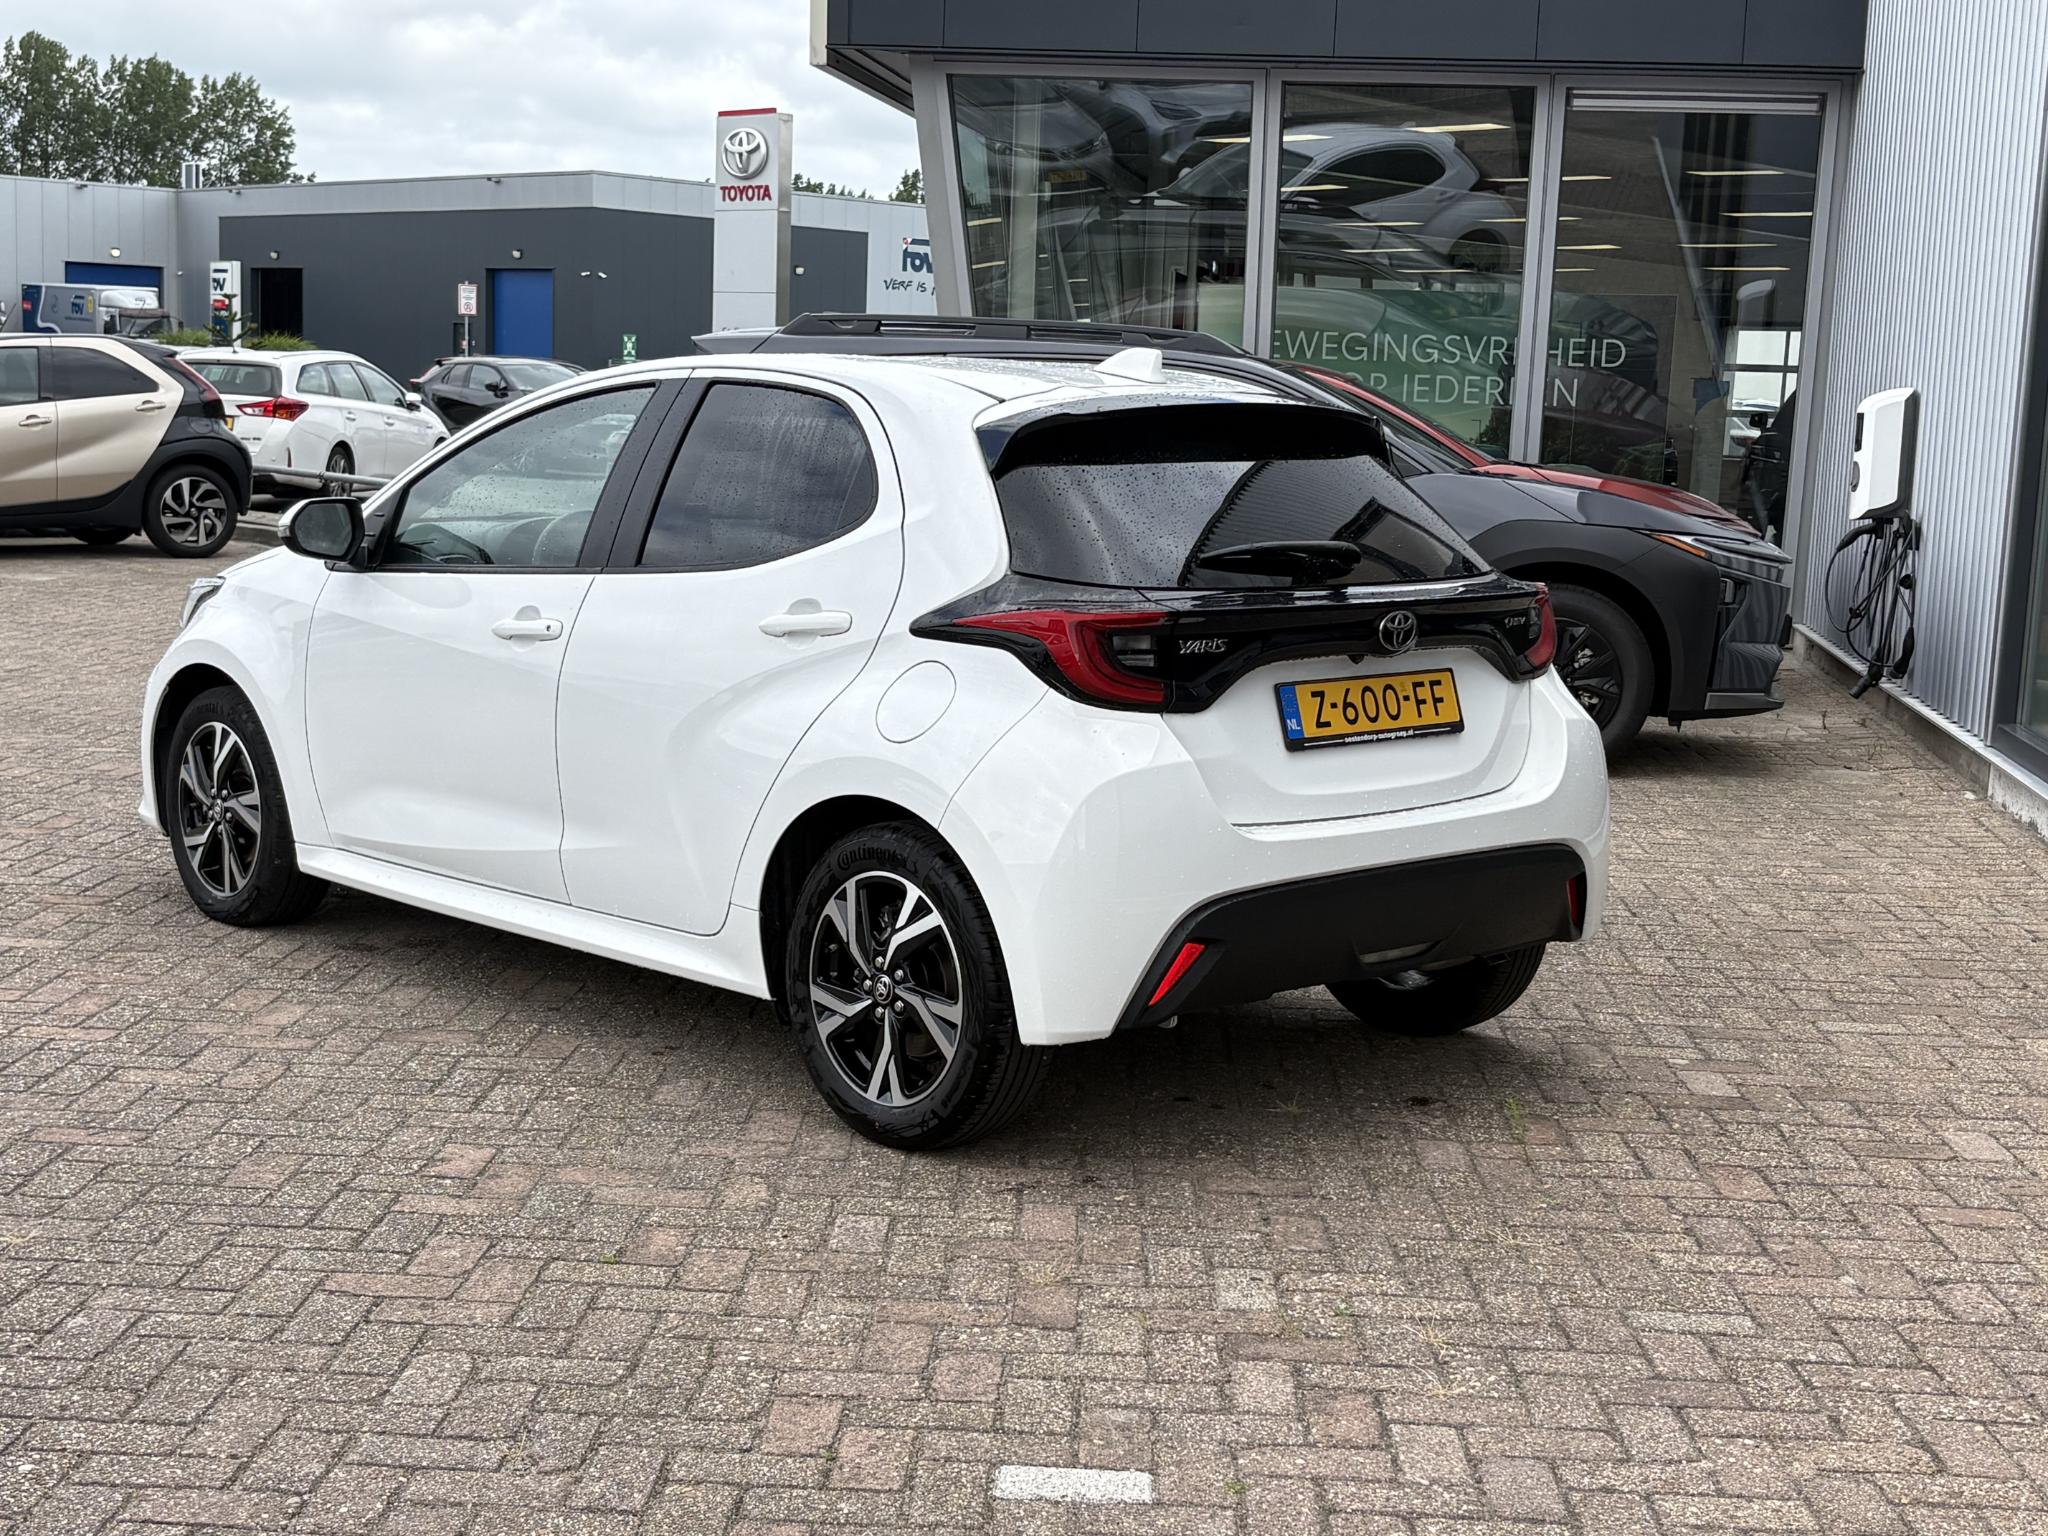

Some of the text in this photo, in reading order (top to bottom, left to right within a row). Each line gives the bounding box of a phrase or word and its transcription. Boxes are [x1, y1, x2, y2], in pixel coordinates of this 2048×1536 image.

[720, 185, 772, 202] TOYOTA
[883, 278, 913, 292] VERF
[916, 281, 927, 293] IS
[1179, 638, 1229, 654] YARIS
[1287, 679, 1444, 731] NL Z-600-FF
